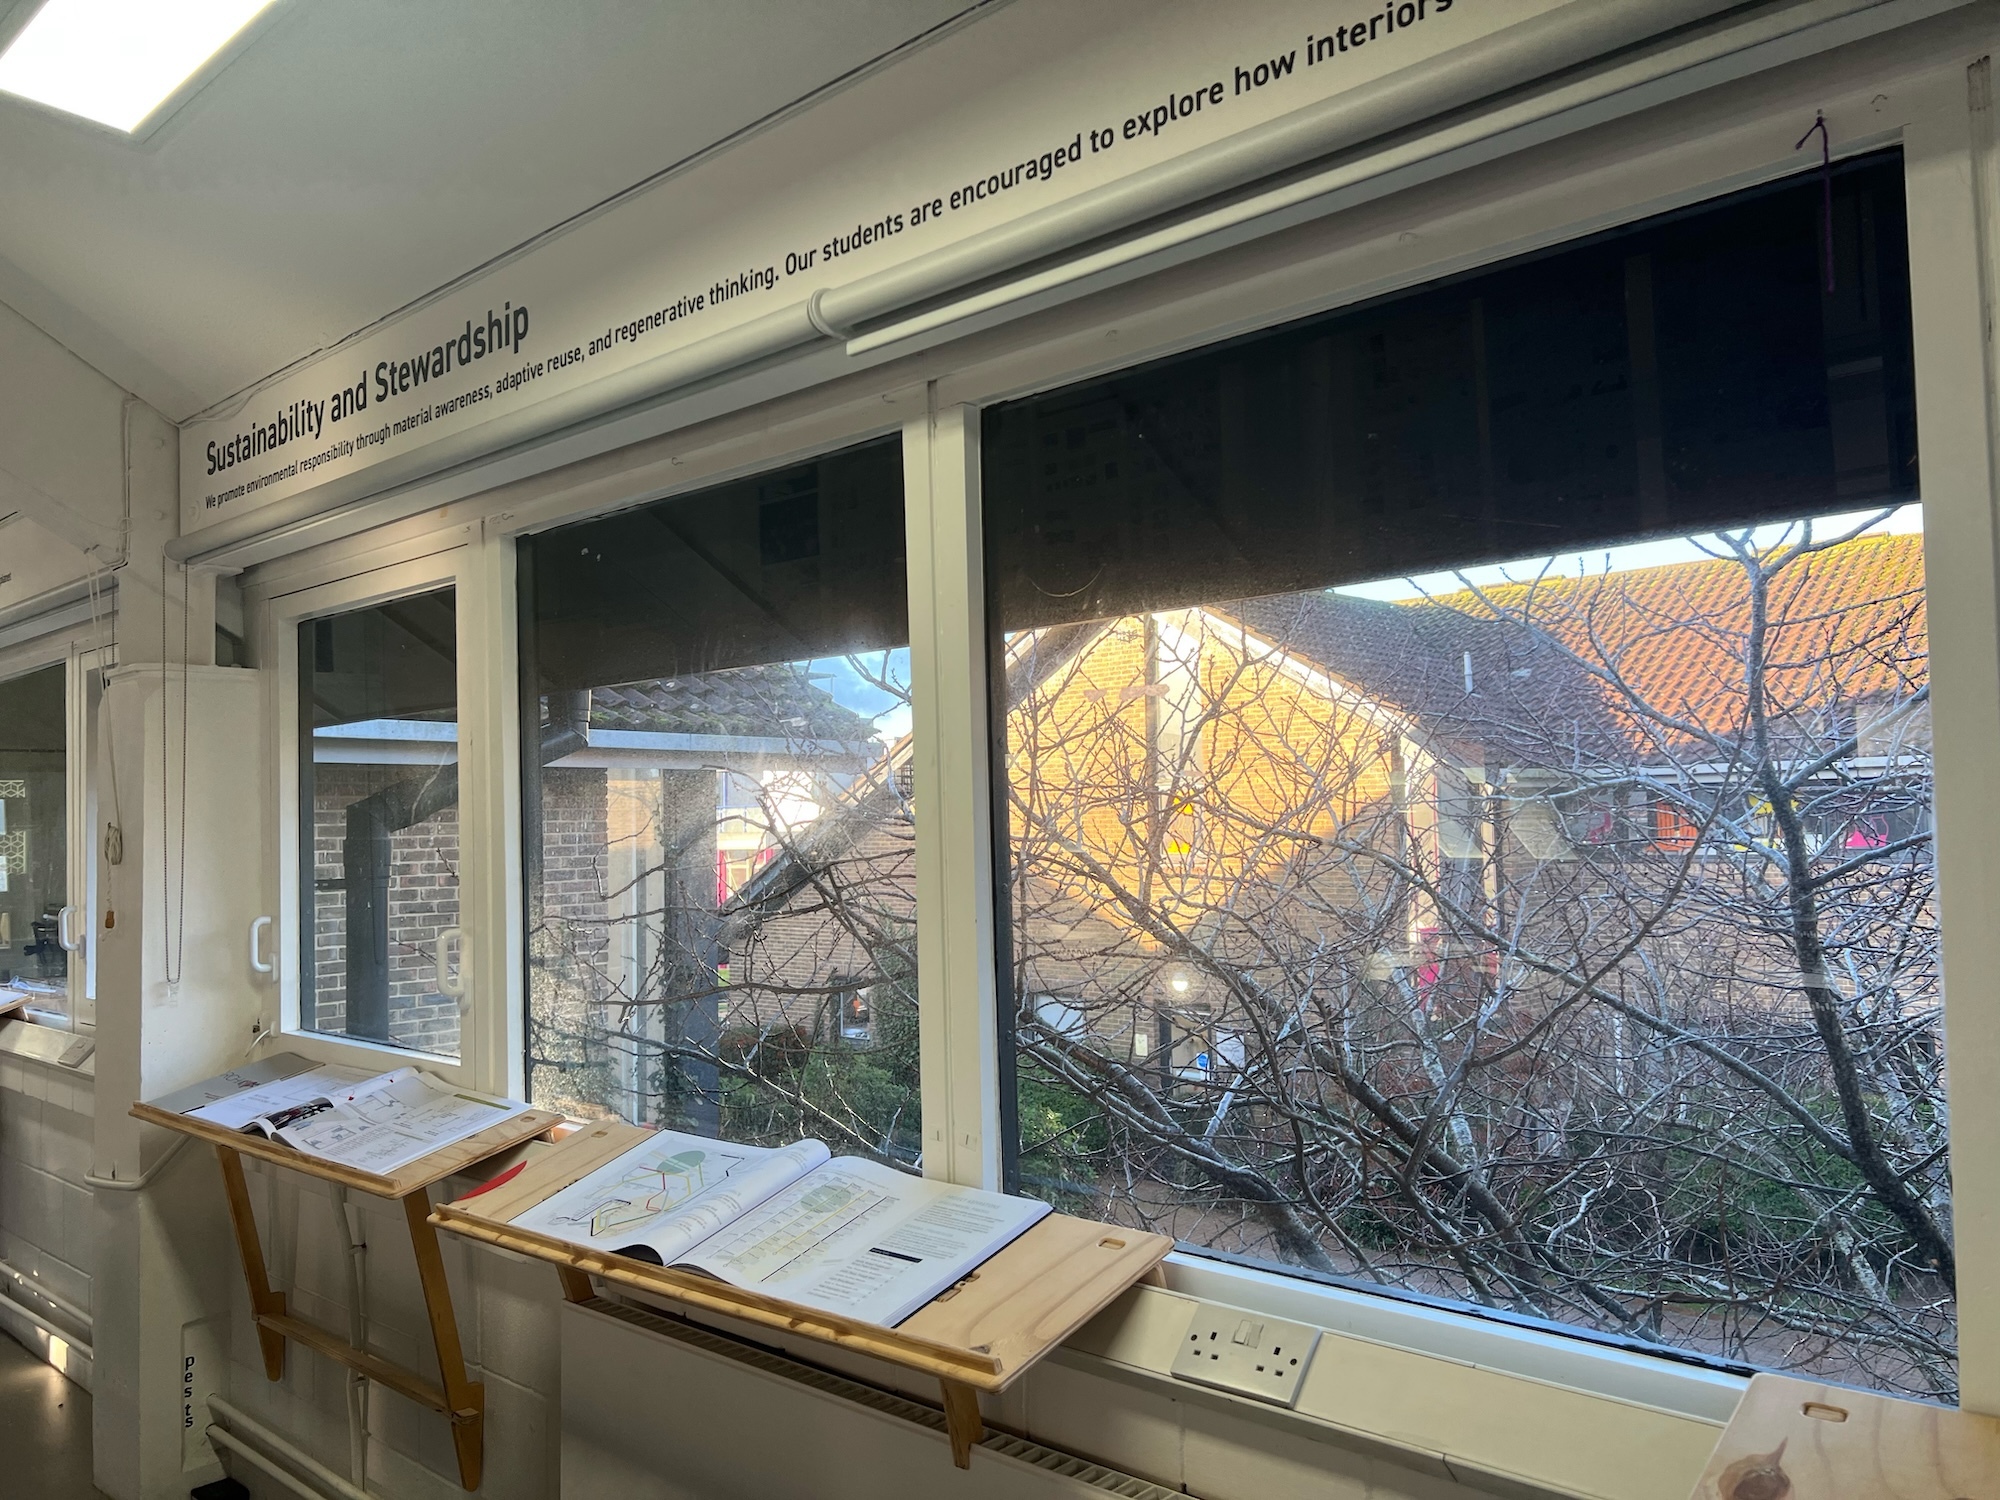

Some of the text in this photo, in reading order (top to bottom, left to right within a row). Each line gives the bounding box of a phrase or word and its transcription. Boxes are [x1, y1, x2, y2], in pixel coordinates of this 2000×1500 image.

[206, 495, 216, 509] We
[218, 485, 245, 508] promote
[247, 460, 298, 493] environmental
[300, 441, 354, 472] responsibility
[356, 423, 390, 450] through
[393, 405, 432, 436] material
[435, 385, 492, 418] awareness,
[496, 363, 543, 393] adaptive
[547, 347, 584, 373] reuse,
[589, 328, 611, 356] and
[615, 295, 704, 343] regenerative
[709, 267, 779, 305] thinking.
[786, 249, 817, 275] Our
[823, 214, 903, 262] students
[911, 199, 942, 226] are
[950, 133, 1081, 210] encouraged
[1090, 128, 1114, 153] to
[1123, 82, 1224, 140] explore
[1235, 50, 1296, 96] how
[207, 301, 529, 475] Sustainability and Stewardship
[184, 1357, 194, 1428] pests
